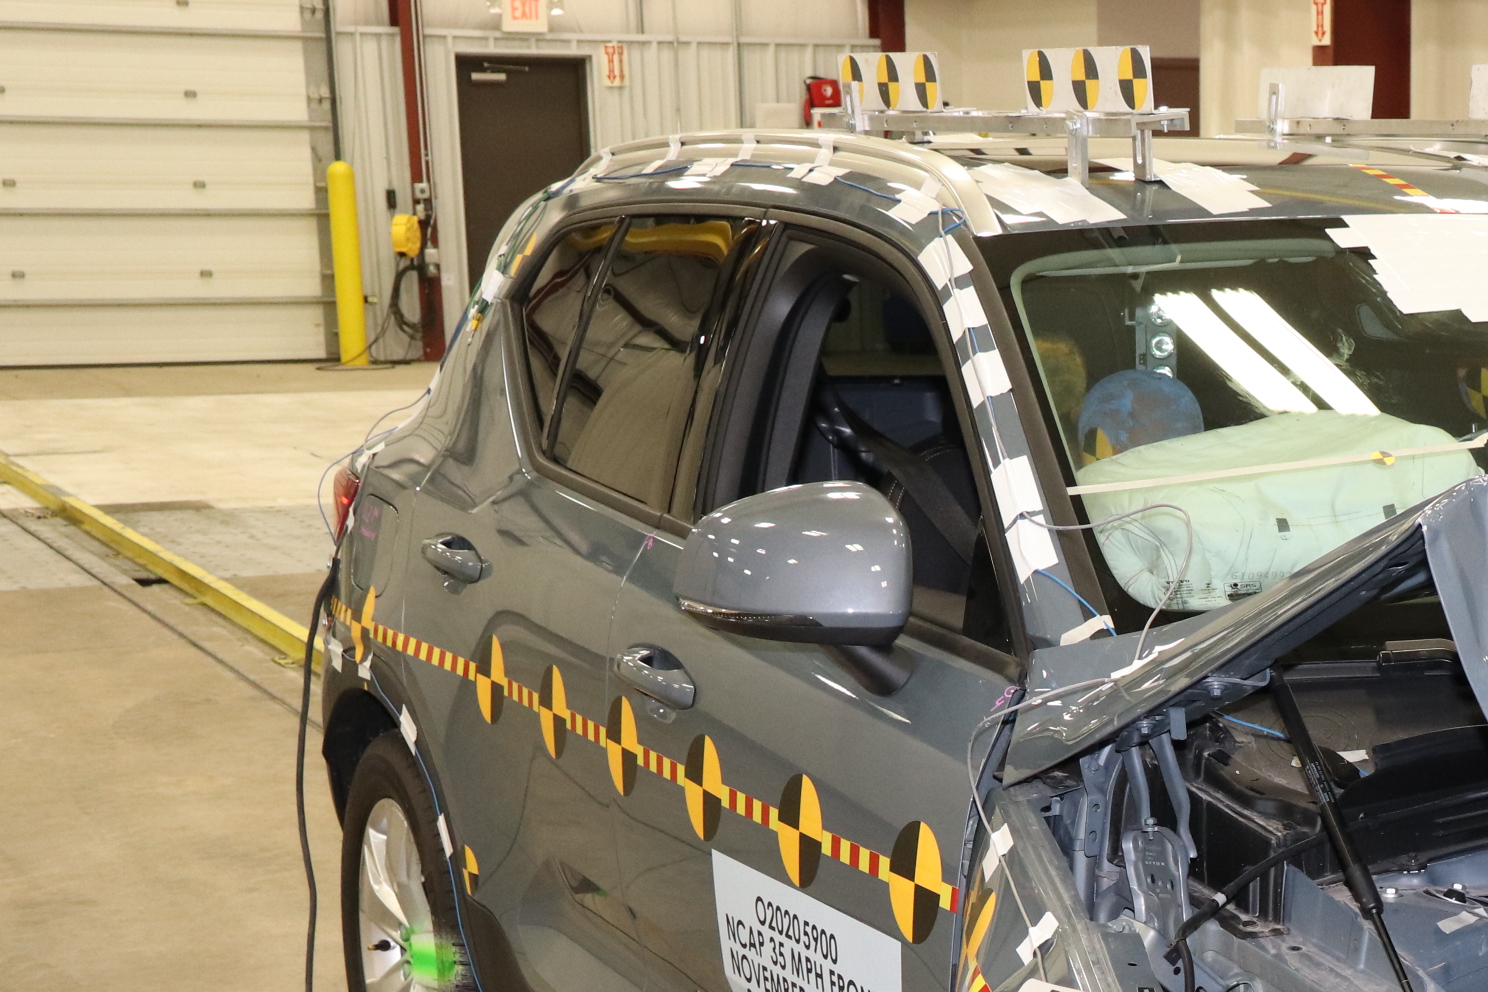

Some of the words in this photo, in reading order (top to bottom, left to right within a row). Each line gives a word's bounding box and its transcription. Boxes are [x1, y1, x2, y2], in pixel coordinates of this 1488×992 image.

[511, 0, 540, 20] EXIT
[726, 913, 764, 958] NCAP
[769, 936, 787, 971] 35
[791, 947, 825, 992] MPH
